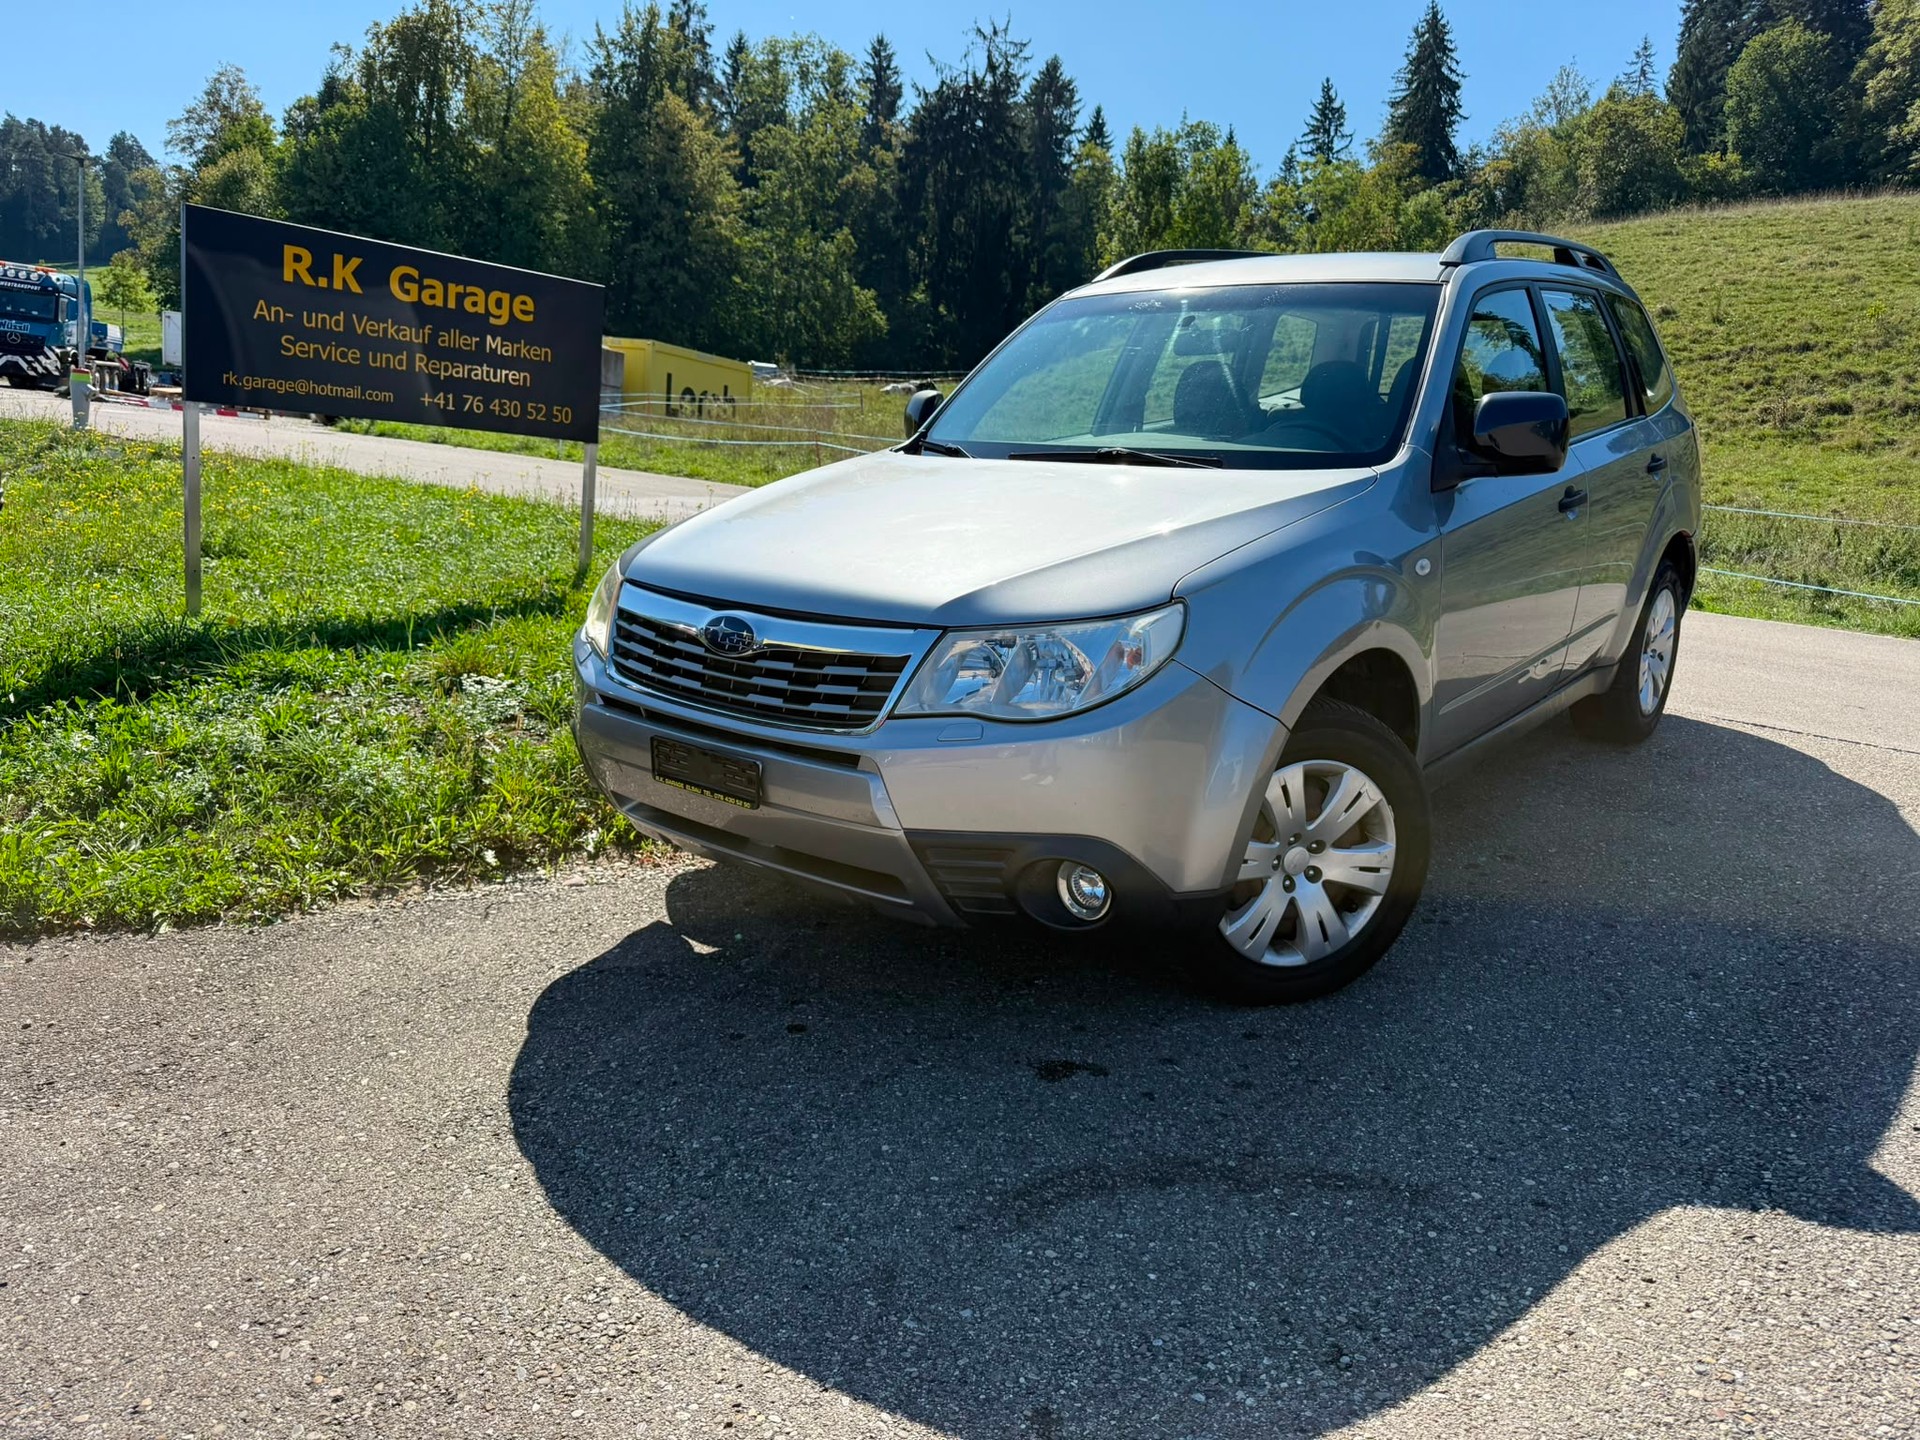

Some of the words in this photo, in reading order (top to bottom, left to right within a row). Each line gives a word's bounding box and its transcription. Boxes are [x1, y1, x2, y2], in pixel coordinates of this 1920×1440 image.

[283, 243, 364, 295] R.K
[389, 265, 536, 327] Garage
[252, 299, 294, 323] An-
[303, 310, 344, 332] und
[352, 313, 433, 345] Verkauf
[437, 328, 480, 351] aller
[485, 334, 552, 363] Marken
[280, 334, 361, 364] Service
[368, 350, 407, 372] und
[415, 353, 531, 387] Reparaturen
[222, 370, 394, 403] rk.garage@hotmail.com
[420, 392, 456, 411] +41
[462, 394, 484, 414] 76
[489, 399, 522, 418] 430
[526, 402, 547, 421] 52
[552, 406, 572, 425] 50
[665, 778, 684, 789] GARAGE
